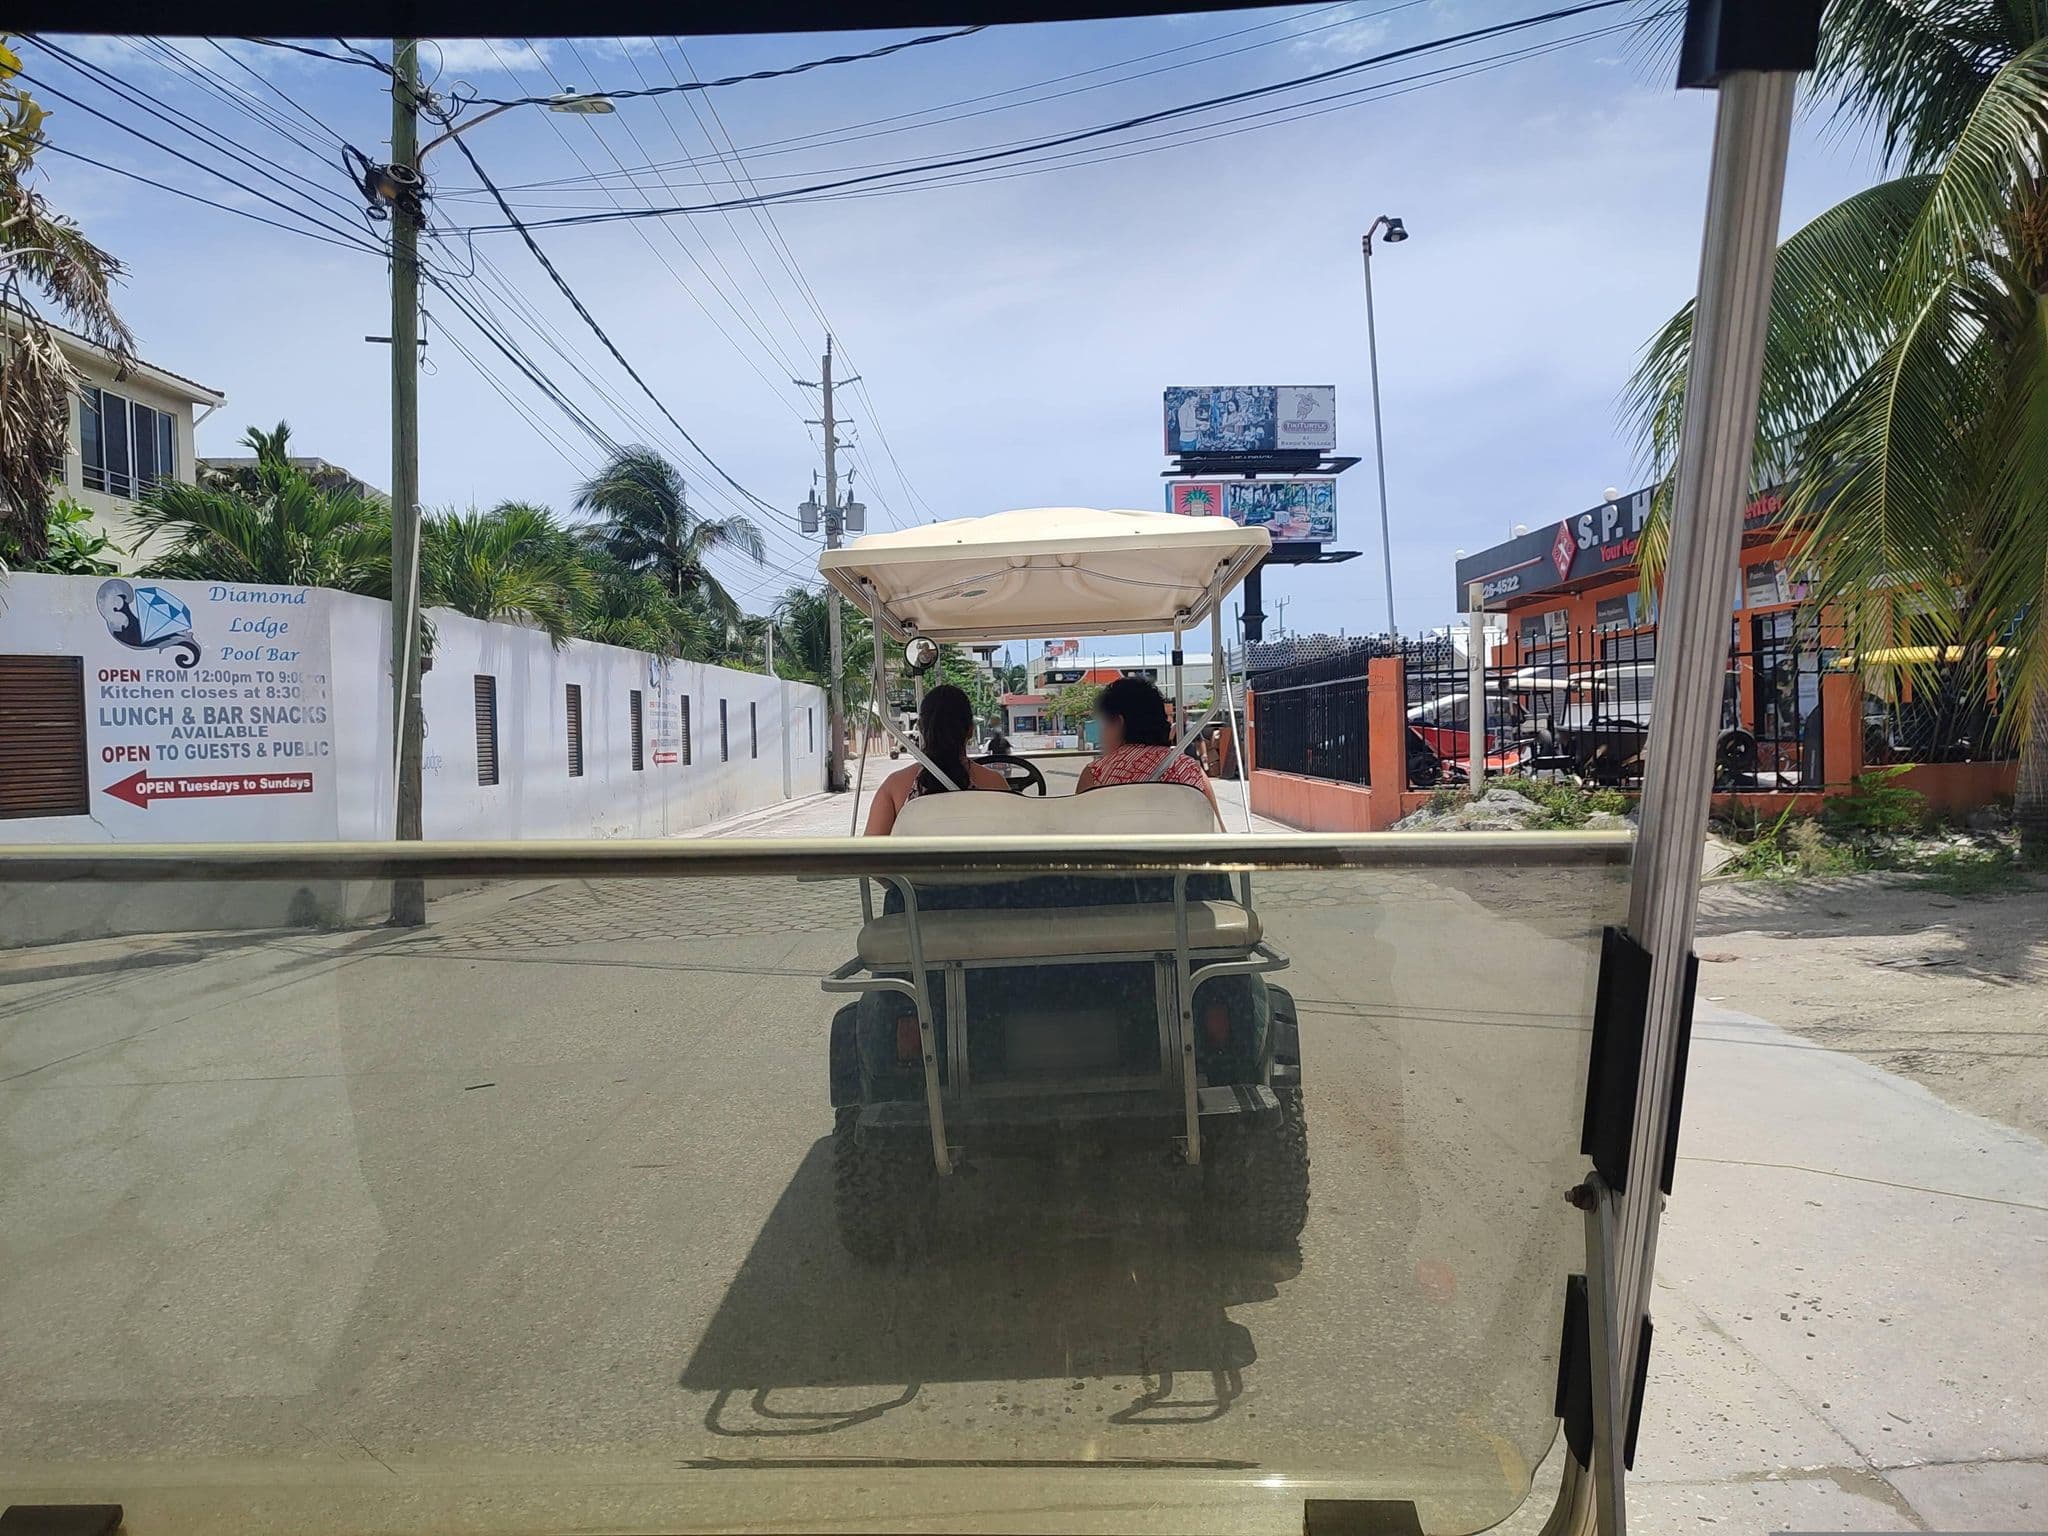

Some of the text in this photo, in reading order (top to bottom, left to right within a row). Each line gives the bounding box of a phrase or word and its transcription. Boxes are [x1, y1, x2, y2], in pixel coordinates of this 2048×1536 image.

[1743, 495, 1784, 520] enter
[1578, 504, 1624, 550] S.P.
[1600, 543, 1622, 563] Your
[209, 586, 311, 605] Diamond
[1481, 575, 1521, 599] 26-4522
[229, 616, 289, 639] Lodge
[221, 645, 301, 661] Pool Bar
[98, 669, 141, 682] OPEN
[145, 669, 188, 682] FROM
[193, 670, 252, 686] 12:00pm
[256, 671, 274, 683] TO
[100, 685, 175, 699] Kitchen
[180, 685, 238, 699] closes
[243, 686, 261, 699] at
[100, 705, 327, 727] LUNCH & BAR SNACKS
[170, 725, 269, 739] AVAILABLE
[102, 741, 329, 763] OPEN TO GUESTS & PUBLIC
[135, 777, 311, 795] OPEN Tuesdays to Sundays
